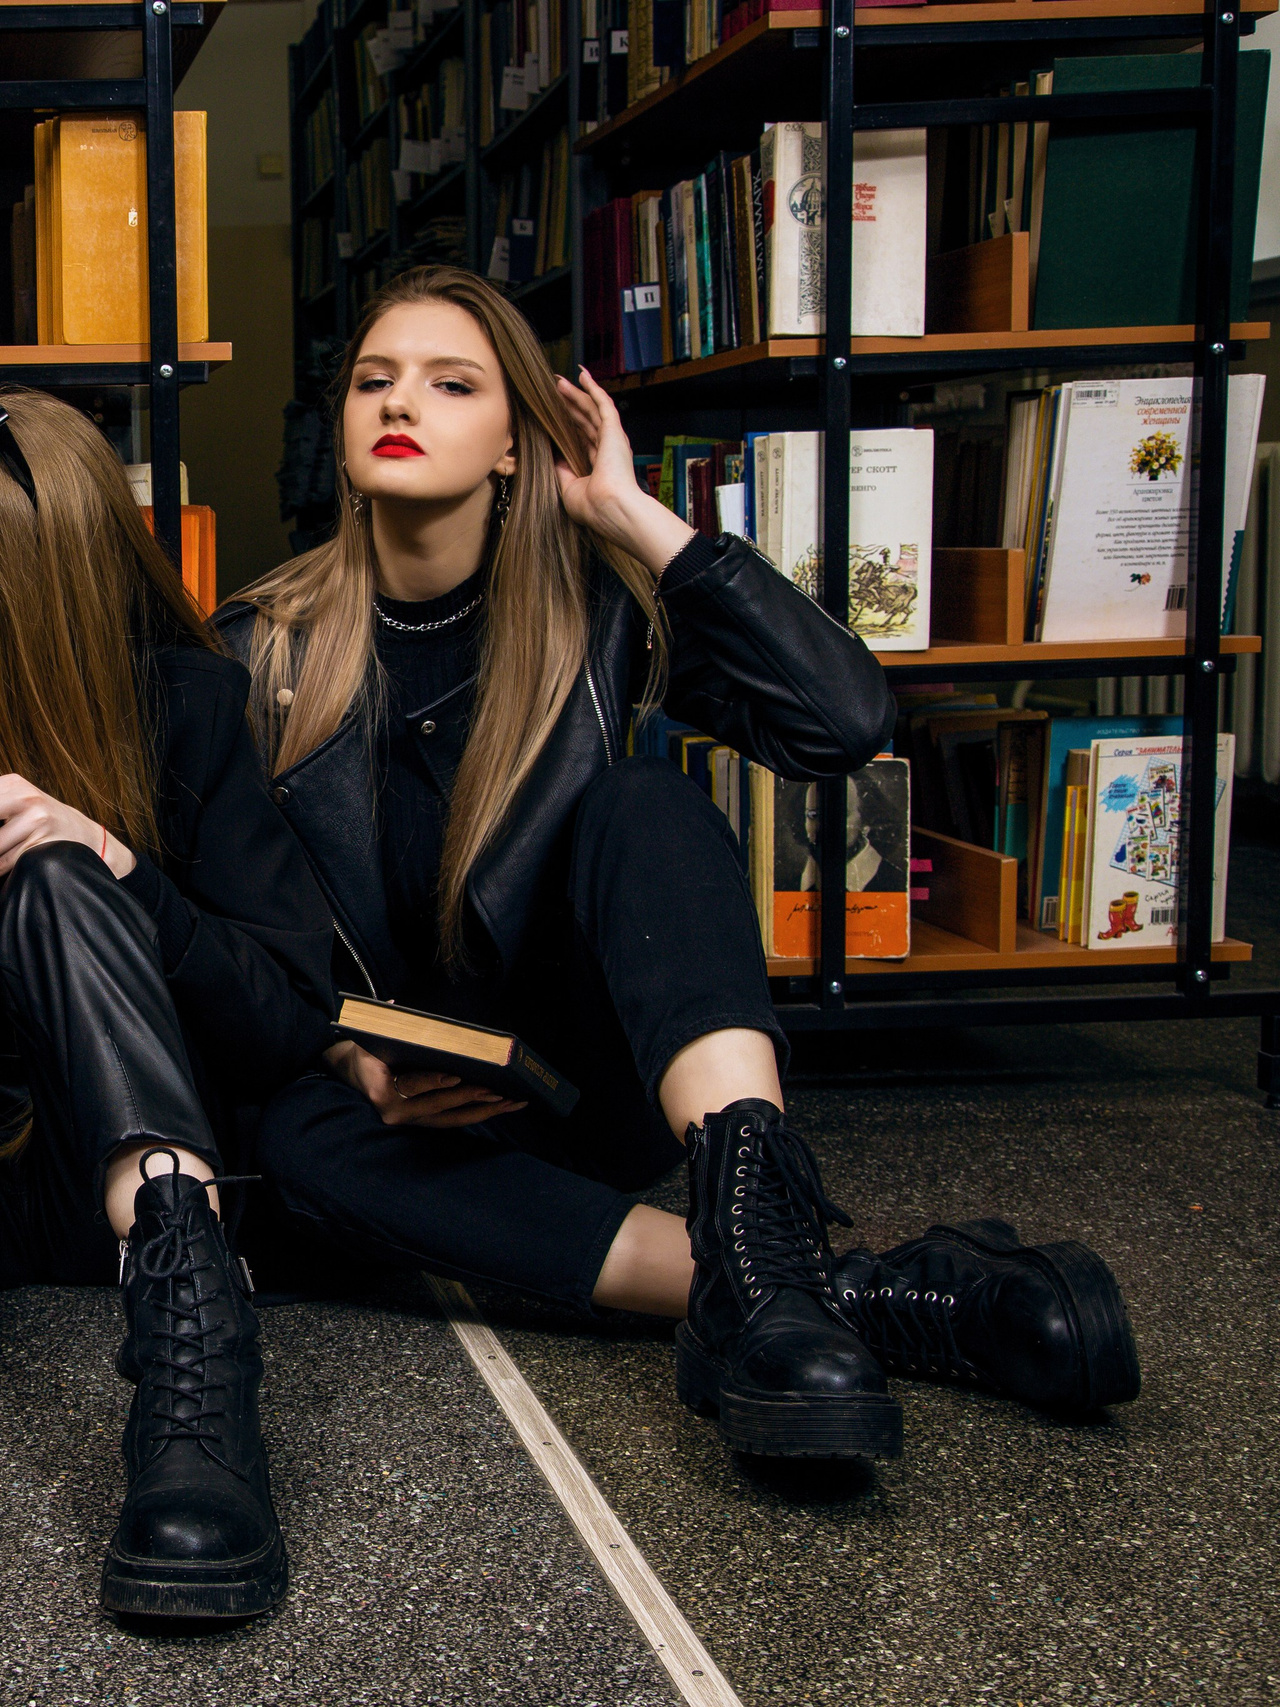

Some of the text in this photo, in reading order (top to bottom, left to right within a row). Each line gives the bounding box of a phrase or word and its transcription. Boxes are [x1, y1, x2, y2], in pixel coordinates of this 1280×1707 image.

[644, 292, 655, 303] П
[1134, 394, 1192, 406] Энциклопедия
[1136, 404, 1188, 417] современной
[1141, 416, 1182, 427] женщины
[851, 465, 898, 474] ЕР СКОТТ
